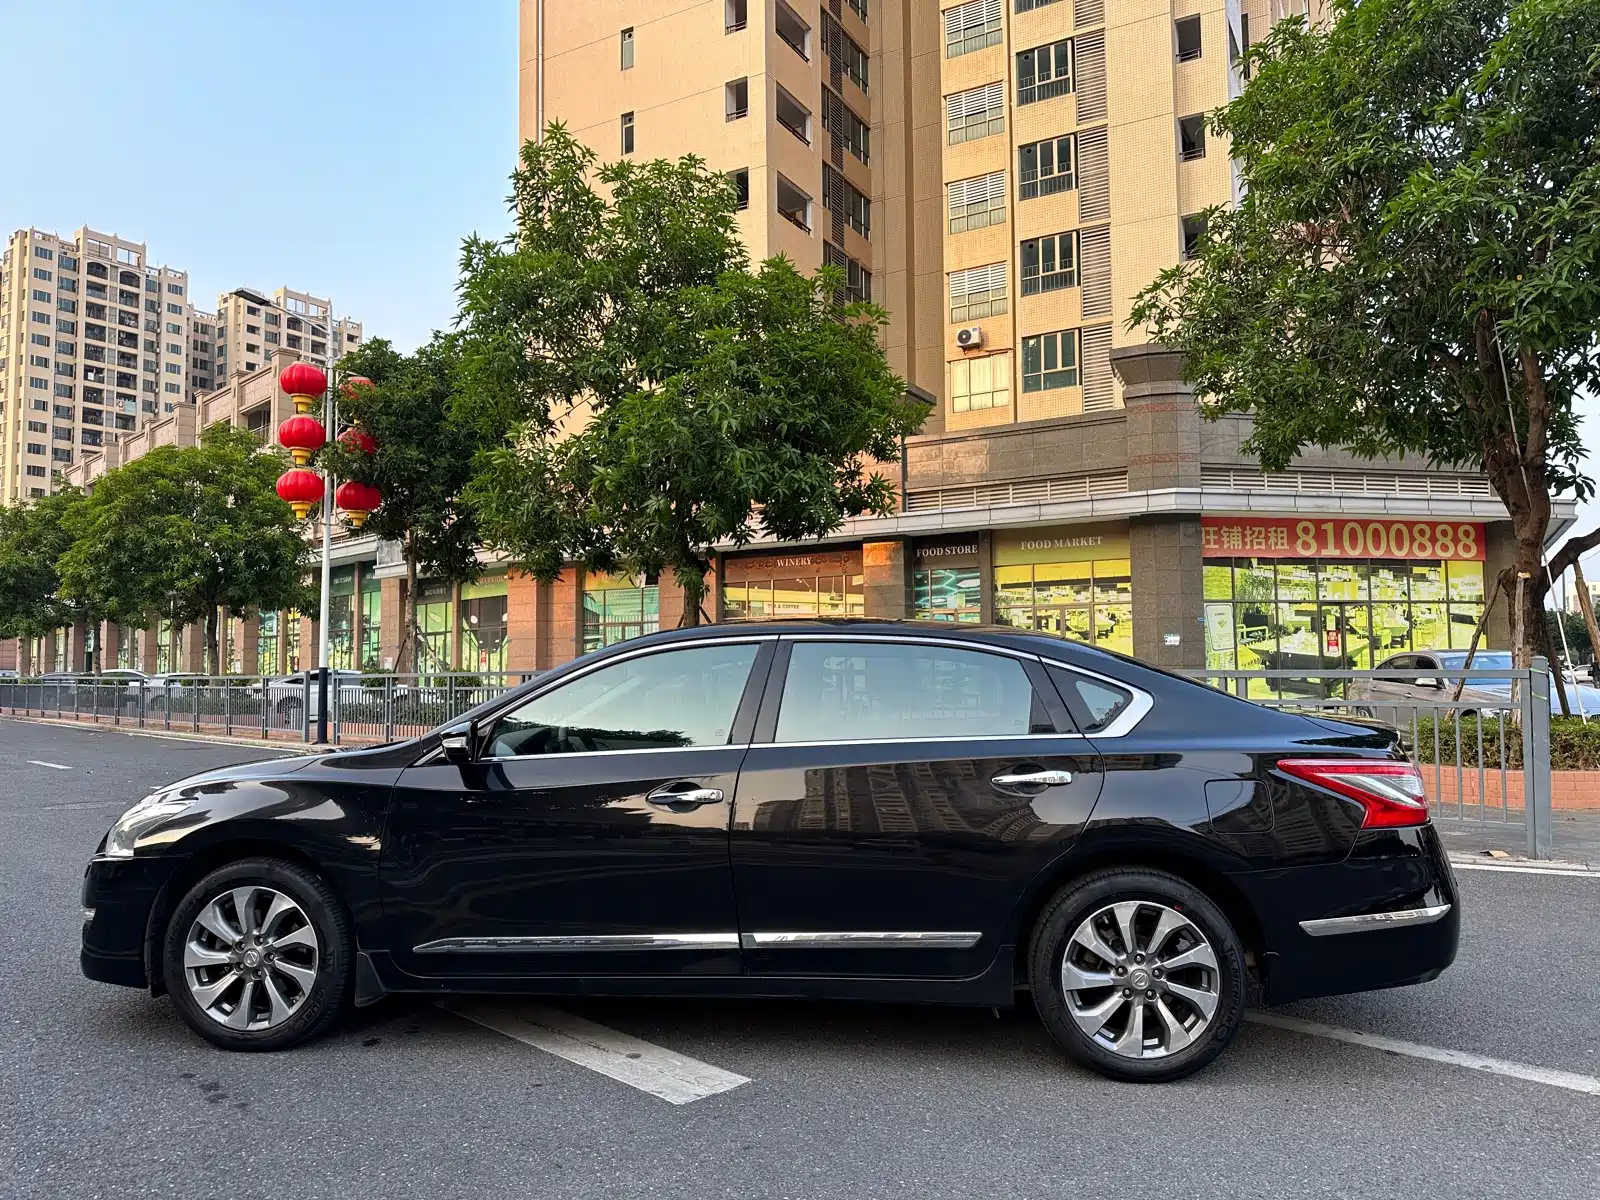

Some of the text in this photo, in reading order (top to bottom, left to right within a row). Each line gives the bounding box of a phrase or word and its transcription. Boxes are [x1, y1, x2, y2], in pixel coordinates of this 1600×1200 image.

[1021, 536, 1104, 550] FOOD MARKET
[1201, 521, 1478, 558] 旺铺招租 81000888
[916, 544, 979, 558] FOOD STORE
[776, 556, 813, 567] WINERY
